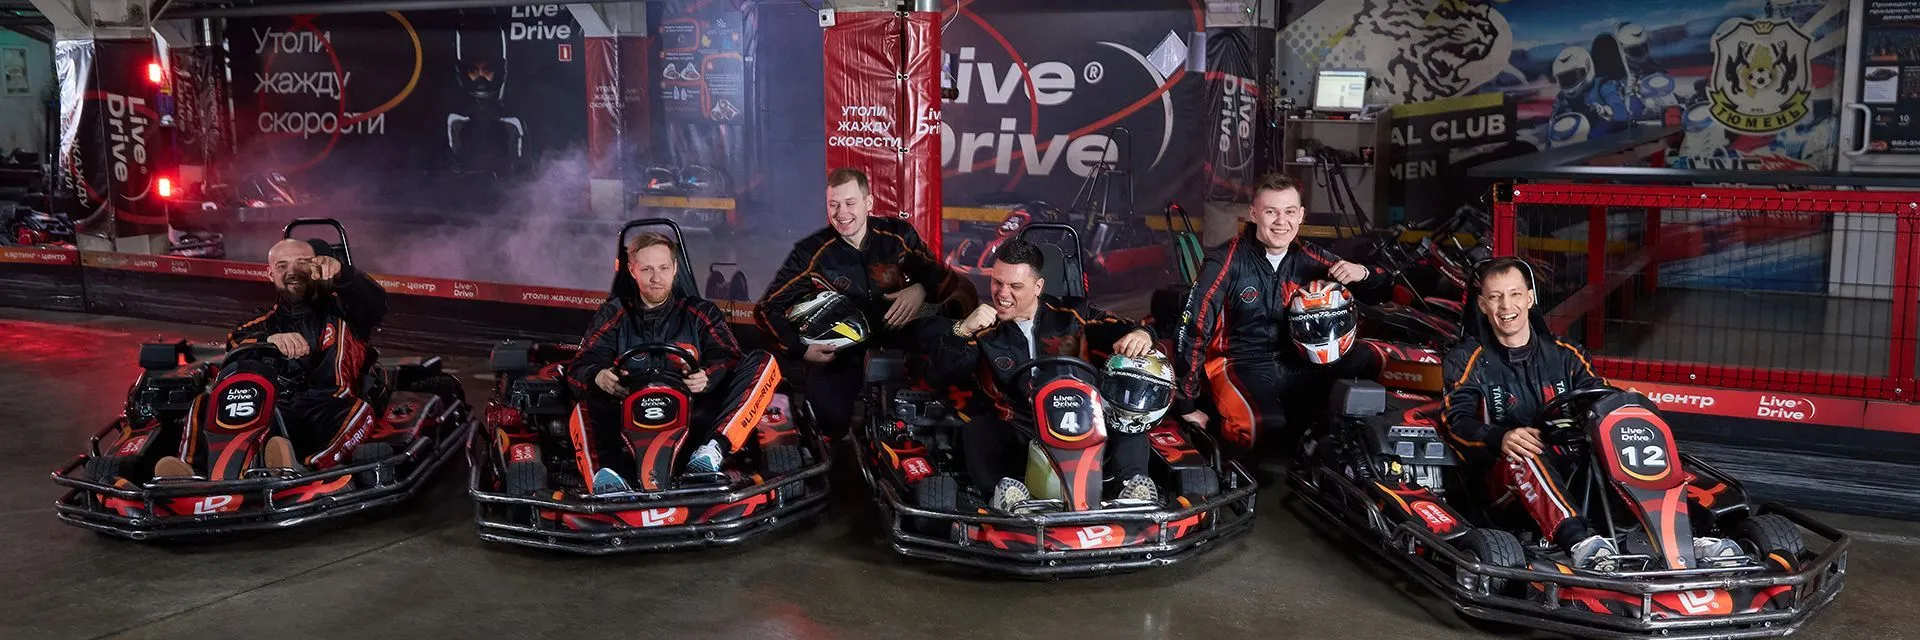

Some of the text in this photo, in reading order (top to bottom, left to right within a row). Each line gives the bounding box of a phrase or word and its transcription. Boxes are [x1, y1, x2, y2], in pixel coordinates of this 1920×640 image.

[510, 21, 571, 40] Drive
[252, 27, 331, 54] Утоли
[254, 72, 351, 100] жажду
[842, 105, 887, 117] УТОЛИ
[1219, 74, 1238, 152] Drive
[1238, 77, 1257, 138] Live
[258, 111, 385, 139] скорости
[1715, 106, 1801, 129] ТЮМЕНЬ
[127, 95, 148, 165] Live
[837, 121, 891, 134] ЖАЖДУ
[1430, 114, 1506, 142] CLUB
[106, 92, 129, 182] Drive
[829, 136, 902, 148] СКОРОСТИ
[41, 252, 67, 262] центр
[407, 282, 436, 291] центр
[453, 289, 474, 297] Drive
[454, 282, 471, 290] Live
[522, 291, 549, 301] утоли
[550, 294, 582, 304] жажду
[1647, 391, 1715, 408] центр
[1759, 395, 1796, 408] Live
[225, 401, 255, 417] 15
[644, 407, 665, 420] 8
[1757, 406, 1805, 420] Drive
[1060, 411, 1080, 433] 4
[1620, 427, 1643, 435] Live
[1621, 434, 1650, 442] Drive
[1621, 445, 1666, 466] 12
